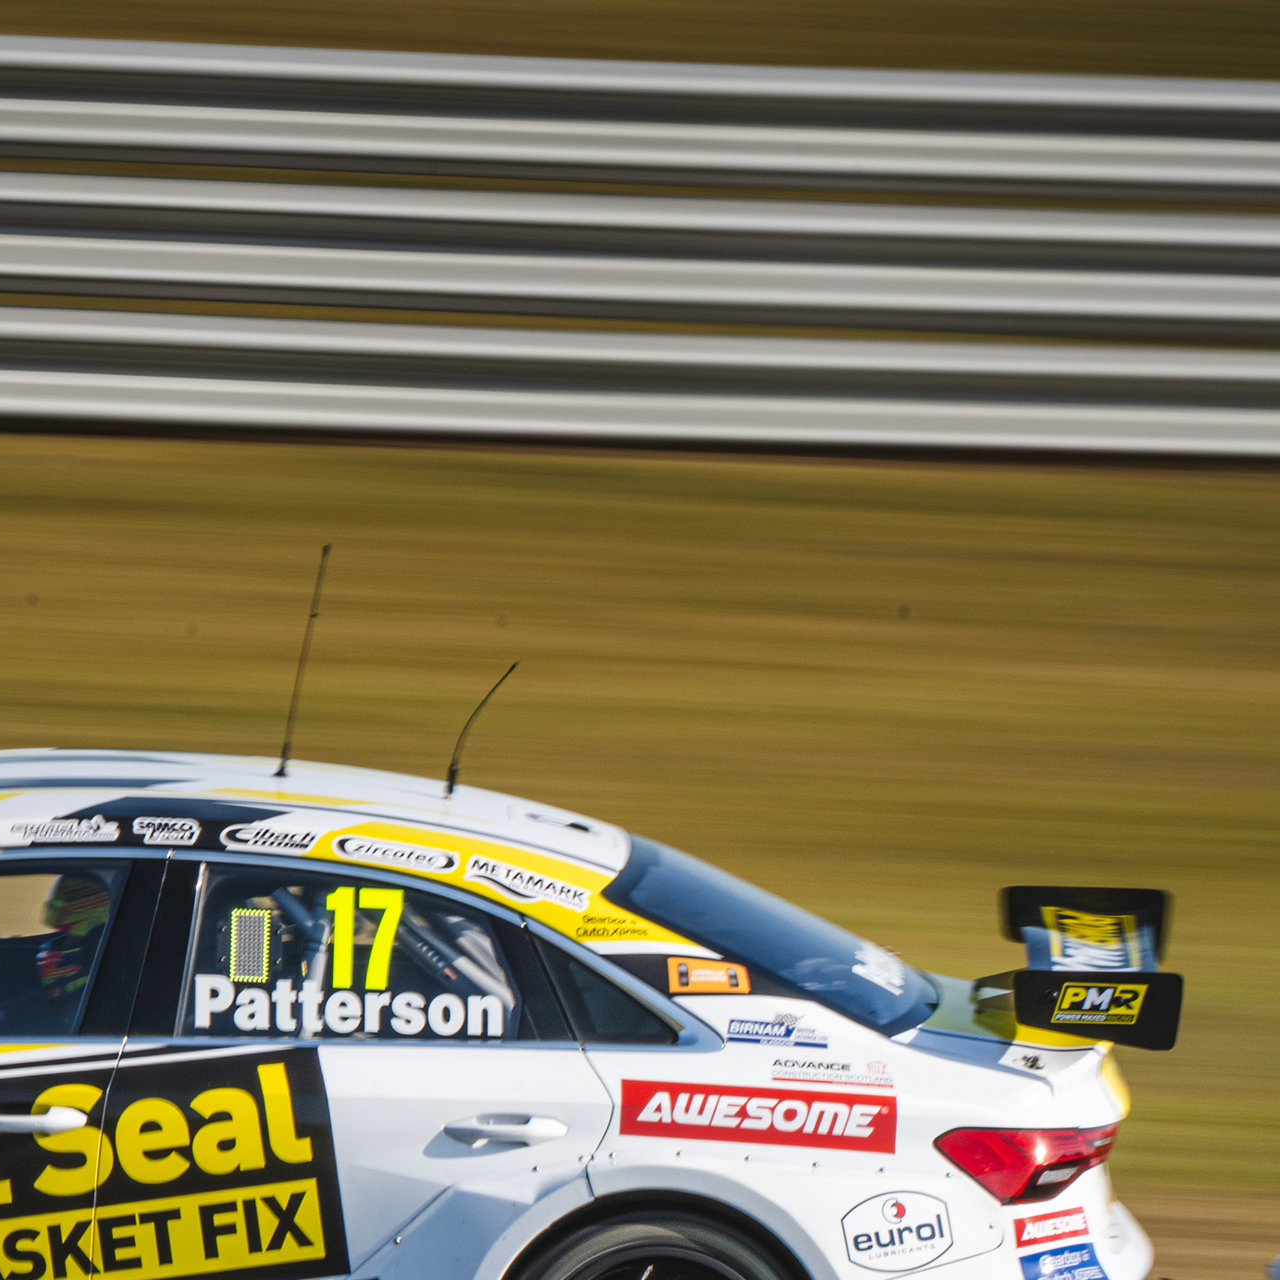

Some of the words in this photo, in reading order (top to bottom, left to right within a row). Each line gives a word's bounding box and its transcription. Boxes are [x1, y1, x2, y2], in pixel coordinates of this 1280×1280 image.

[471, 859, 584, 900] METAMARK
[326, 886, 404, 991] 17
[576, 927, 609, 937] Clutch
[194, 974, 504, 1037] Patterson
[1060, 986, 1139, 1011] PMR
[728, 1020, 788, 1037] BIRNAM
[772, 1059, 851, 1072] ADVANCE
[845, 1073, 893, 1084] SCOTLAND
[30, 1062, 314, 1196] Seal
[637, 1091, 878, 1138] AWESOME
[198, 1190, 316, 1259] FIX
[852, 1213, 945, 1252] eurol
[1020, 1212, 1087, 1242] AWESOME
[868, 1243, 936, 1260] LUBRICANTS
